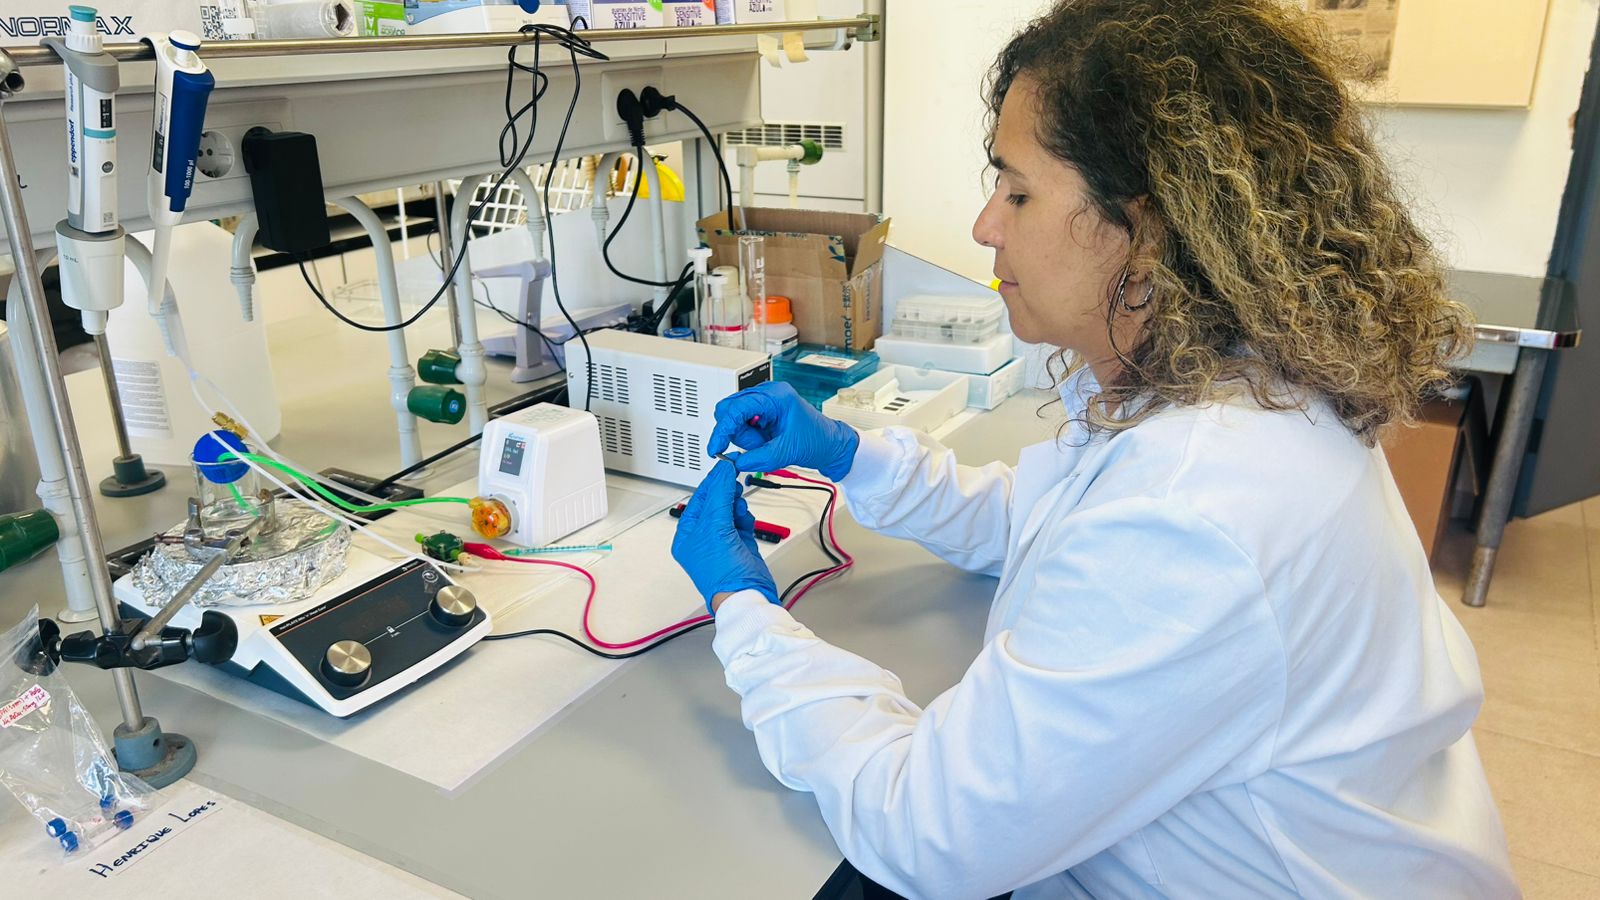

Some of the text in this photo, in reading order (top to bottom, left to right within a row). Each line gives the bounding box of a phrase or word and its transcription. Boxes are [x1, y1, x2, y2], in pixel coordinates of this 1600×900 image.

[614, 11, 647, 21] SENSITIVE
[676, 11, 702, 19] SENSITIVE
[69, 119, 77, 163] eppendorf
[89, 800, 216, 878] HENRIQUE LOPES
